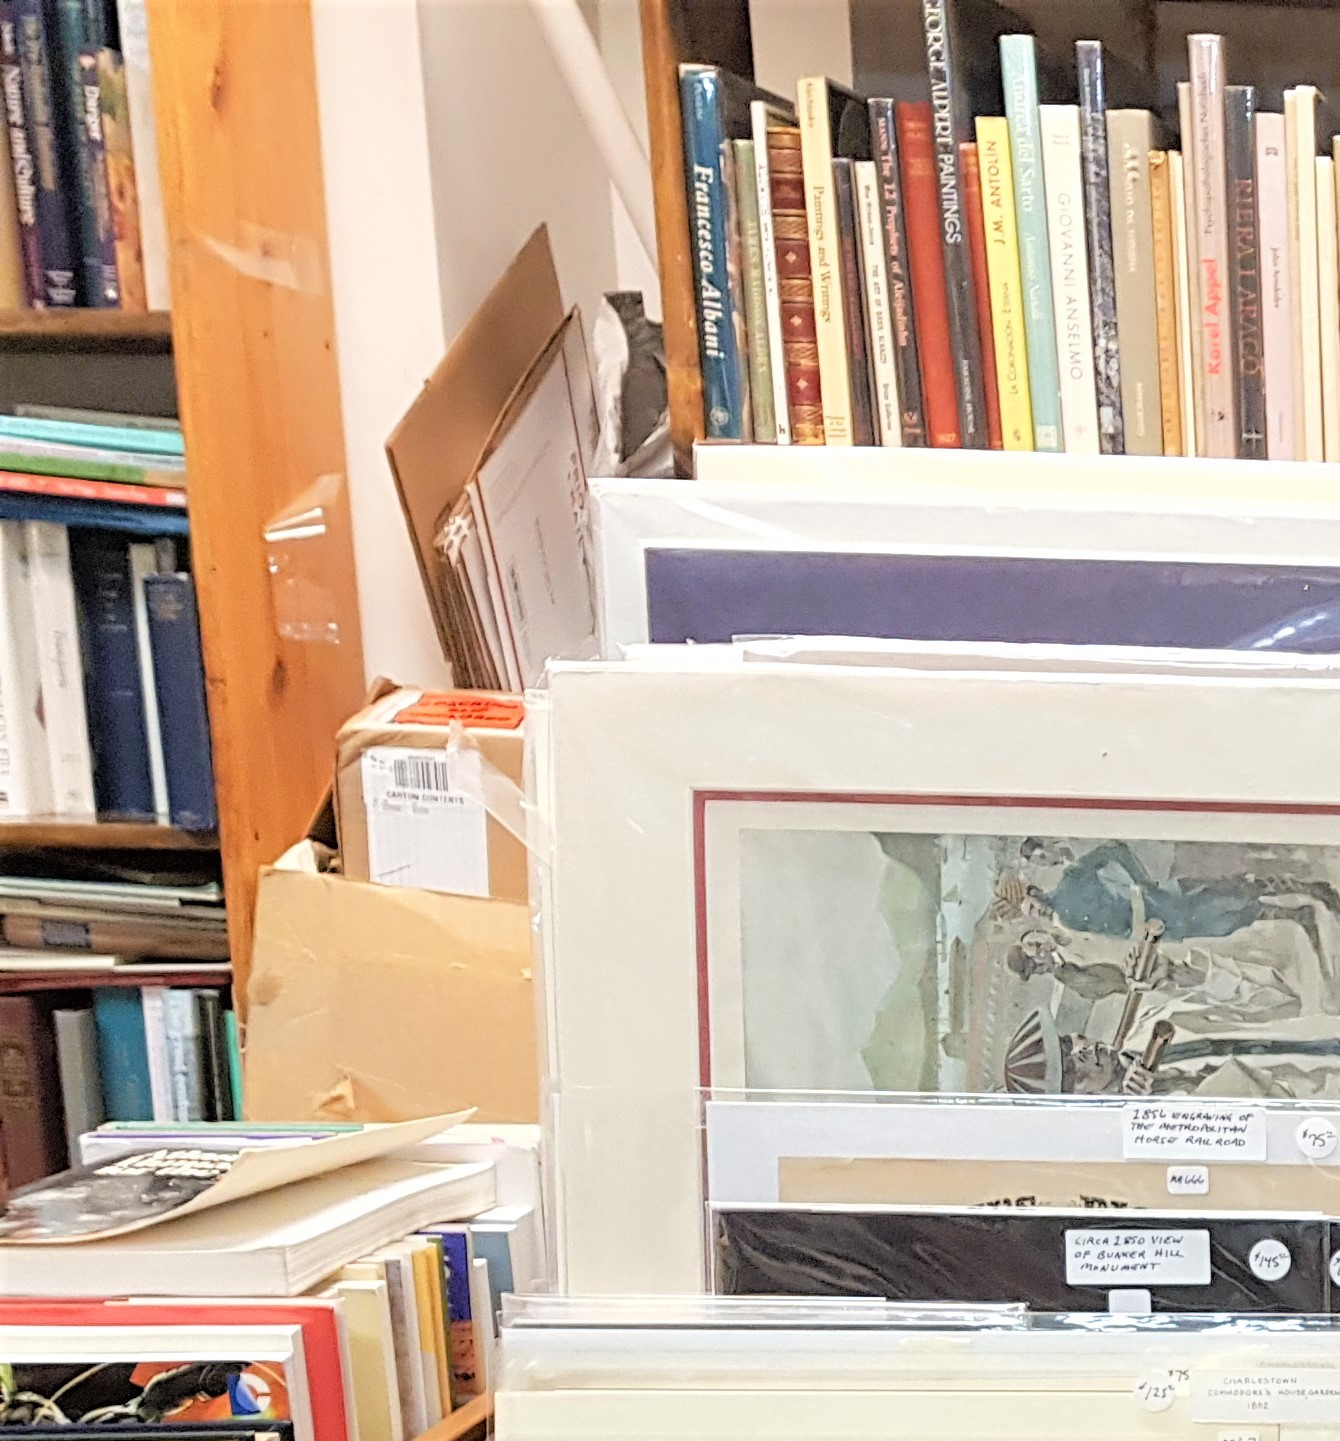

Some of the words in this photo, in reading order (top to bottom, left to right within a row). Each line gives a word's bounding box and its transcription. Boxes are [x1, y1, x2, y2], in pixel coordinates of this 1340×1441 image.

[930, 79, 953, 145] ALPERT
[1017, 138, 1035, 163] del
[881, 155, 893, 177] The
[884, 184, 896, 200] 12
[938, 154, 962, 243] PAINTINGS
[1019, 169, 1036, 212] Sarto
[693, 163, 714, 273] Francesco
[812, 186, 827, 241] Paintings
[885, 205, 900, 254] Prophets
[991, 215, 1006, 245] J.M.
[1057, 193, 1074, 289] GIOVANNI
[818, 247, 829, 268] and
[891, 260, 903, 273] of
[820, 271, 833, 324] Writings
[1202, 258, 1221, 317] Appel
[701, 277, 725, 363] Albani
[1065, 296, 1084, 382] ANSELMO
[1205, 322, 1221, 376] Karel
[386, 790, 420, 801] CARTON
[1130, 1122, 1155, 1132] THE
[1158, 1122, 1249, 1134] METROPOLITAN
[1171, 1111, 1234, 1122] ENGRAVING
[1239, 1112, 1255, 1122] OF
[1134, 1135, 1179, 1146] HORSE
[1218, 1136, 1247, 1148] ROAD
[1074, 1236, 1110, 1247] CIRCA
[1150, 1234, 1184, 1246] VIEW
[1074, 1250, 1092, 1260] OF
[1096, 1250, 1146, 1260] BUNKER
[1153, 1248, 1184, 1259] HILL
[1080, 1261, 1161, 1272] MONUMENT
[1222, 1376, 1298, 1386] CHARLESTOWN
